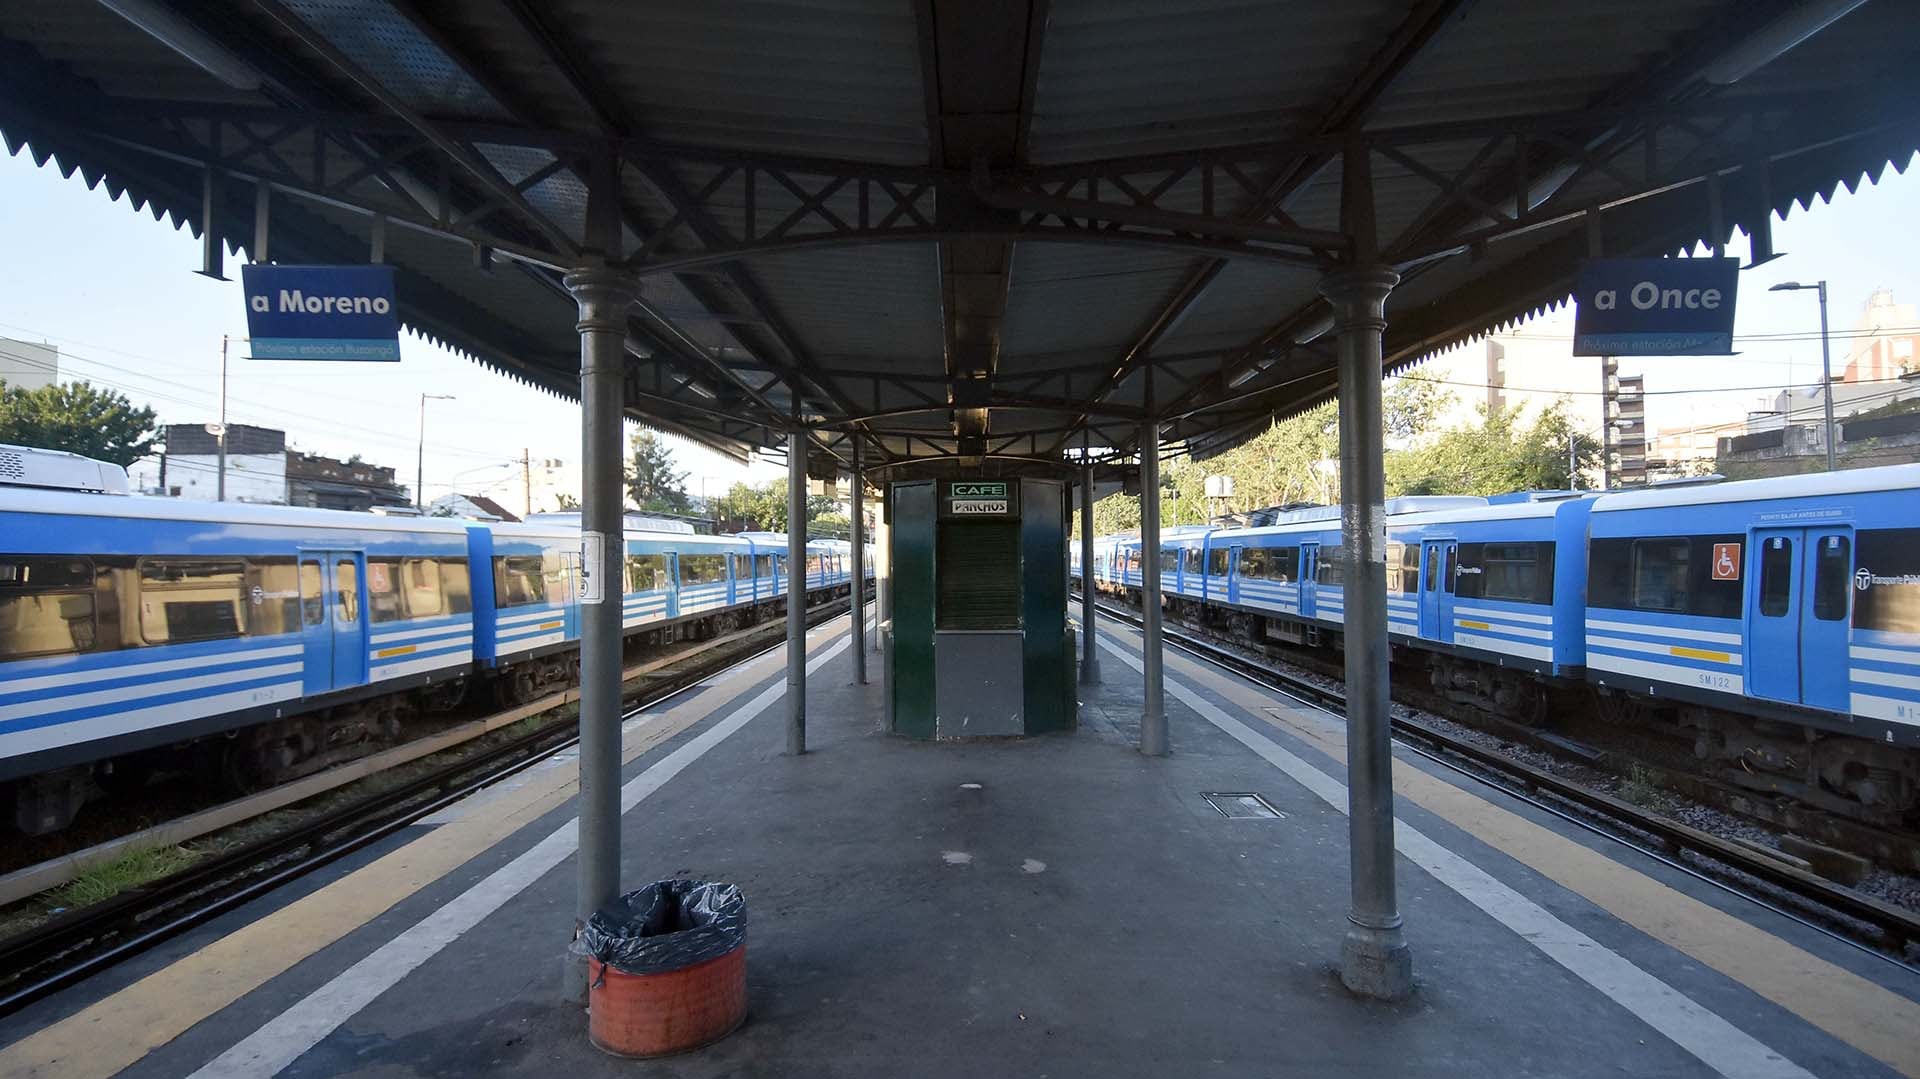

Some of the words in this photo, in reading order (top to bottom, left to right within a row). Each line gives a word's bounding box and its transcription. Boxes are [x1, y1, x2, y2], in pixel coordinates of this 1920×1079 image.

[251, 295, 270, 312] a
[279, 289, 390, 314] Moreno
[1594, 289, 1616, 310] a
[1631, 281, 1721, 310] Once
[955, 486, 1003, 494] CAFE
[955, 503, 1006, 512] PANCHOS
[1699, 674, 1730, 688] SM122
